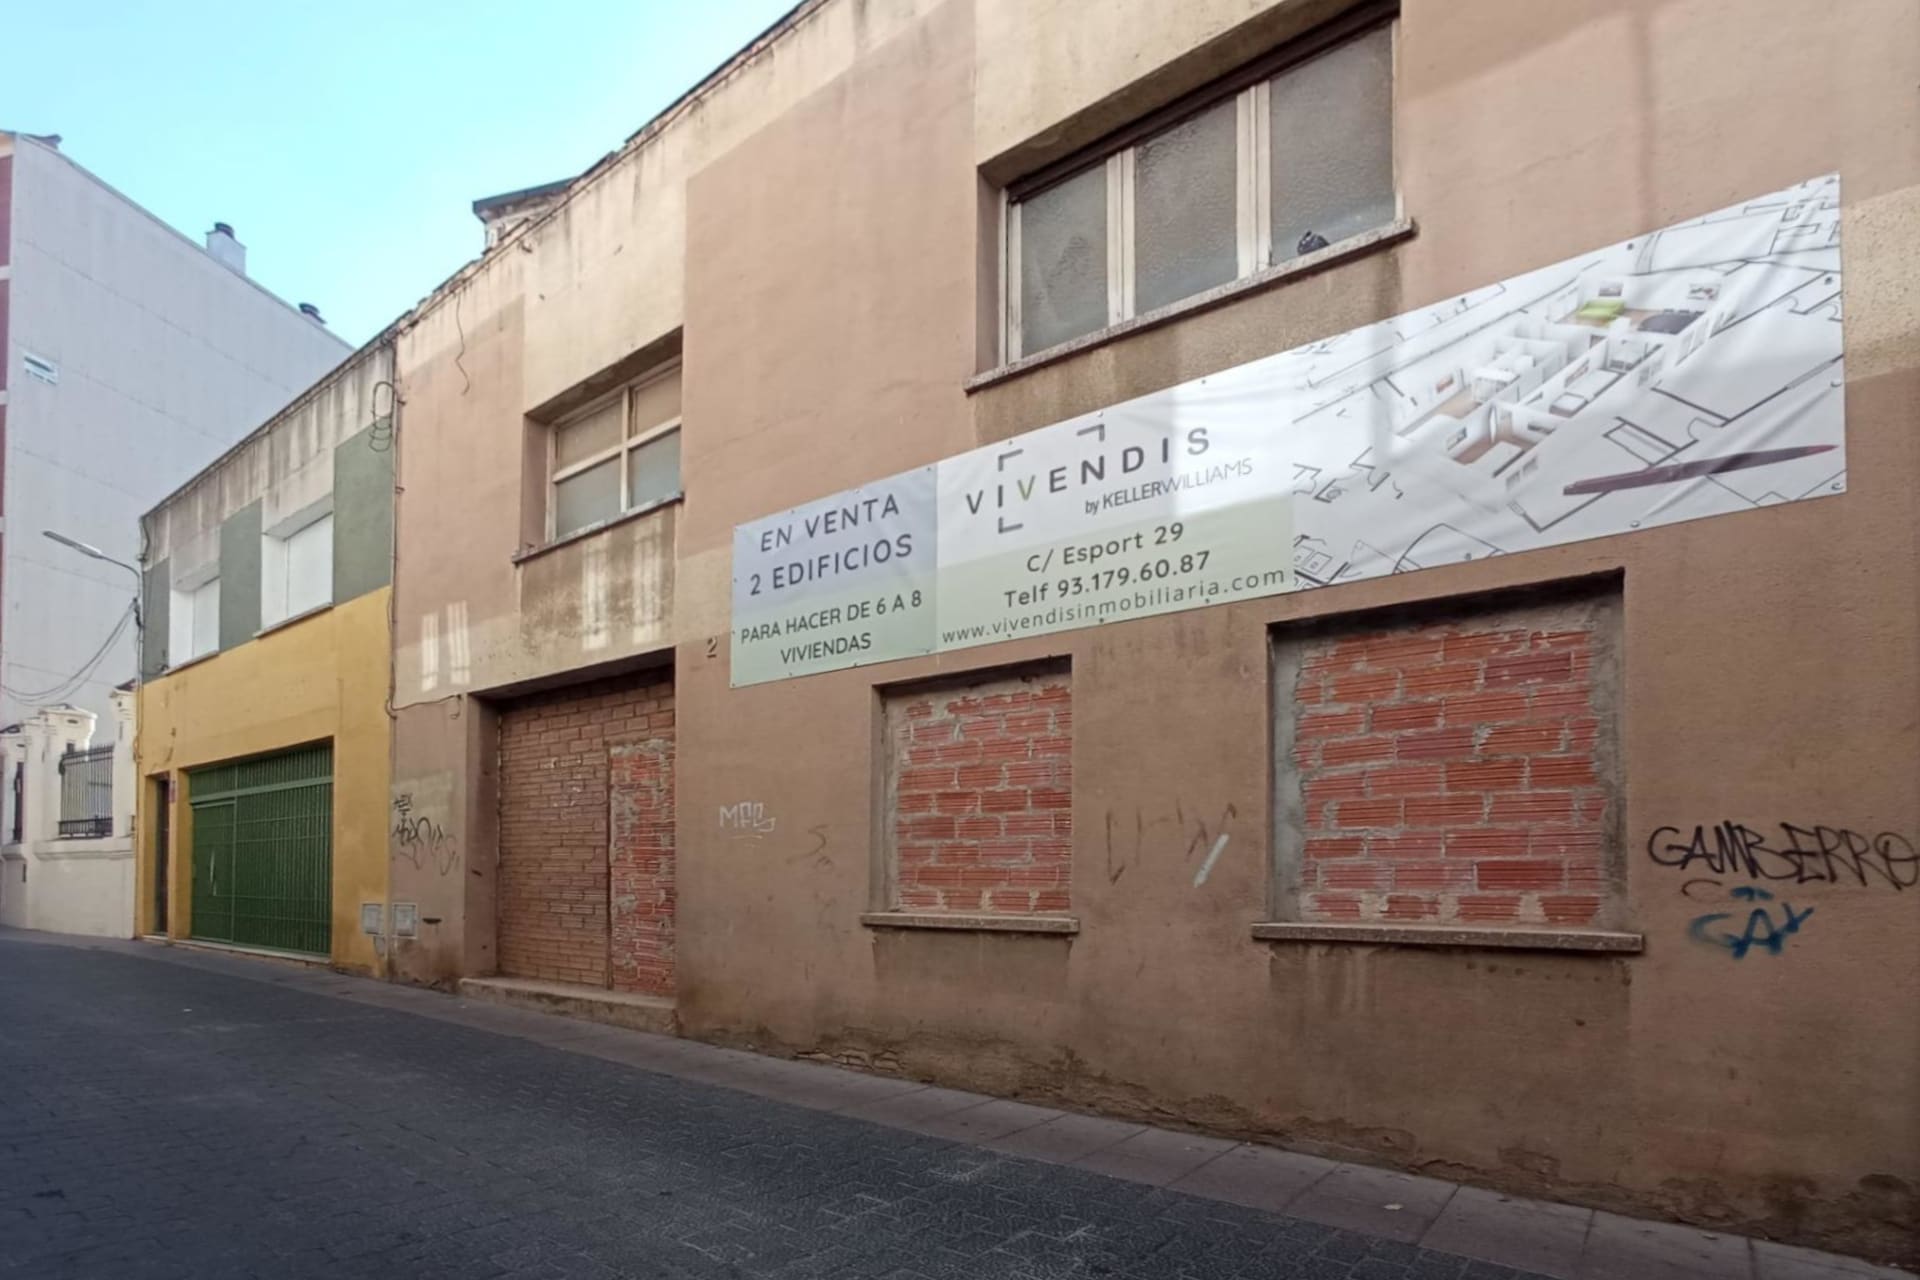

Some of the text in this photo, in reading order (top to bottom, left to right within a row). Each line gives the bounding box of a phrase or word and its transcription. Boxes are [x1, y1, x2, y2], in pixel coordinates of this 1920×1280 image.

[966, 427, 1210, 515] VIVENDIS
[1085, 458, 1252, 515] by KELLERWILLIAMS
[761, 493, 899, 552] EN VENTA
[1027, 522, 1184, 573] C/ Esport 29
[750, 533, 912, 596] 2 EDIFICIOS
[1004, 551, 1211, 608] Telf 93.179.60.87
[741, 590, 922, 644] PARA HACER DE 6 A 8
[942, 569, 1285, 644] www.vivendisinmobiliaria.com
[781, 632, 871, 664] VIVIENDAS
